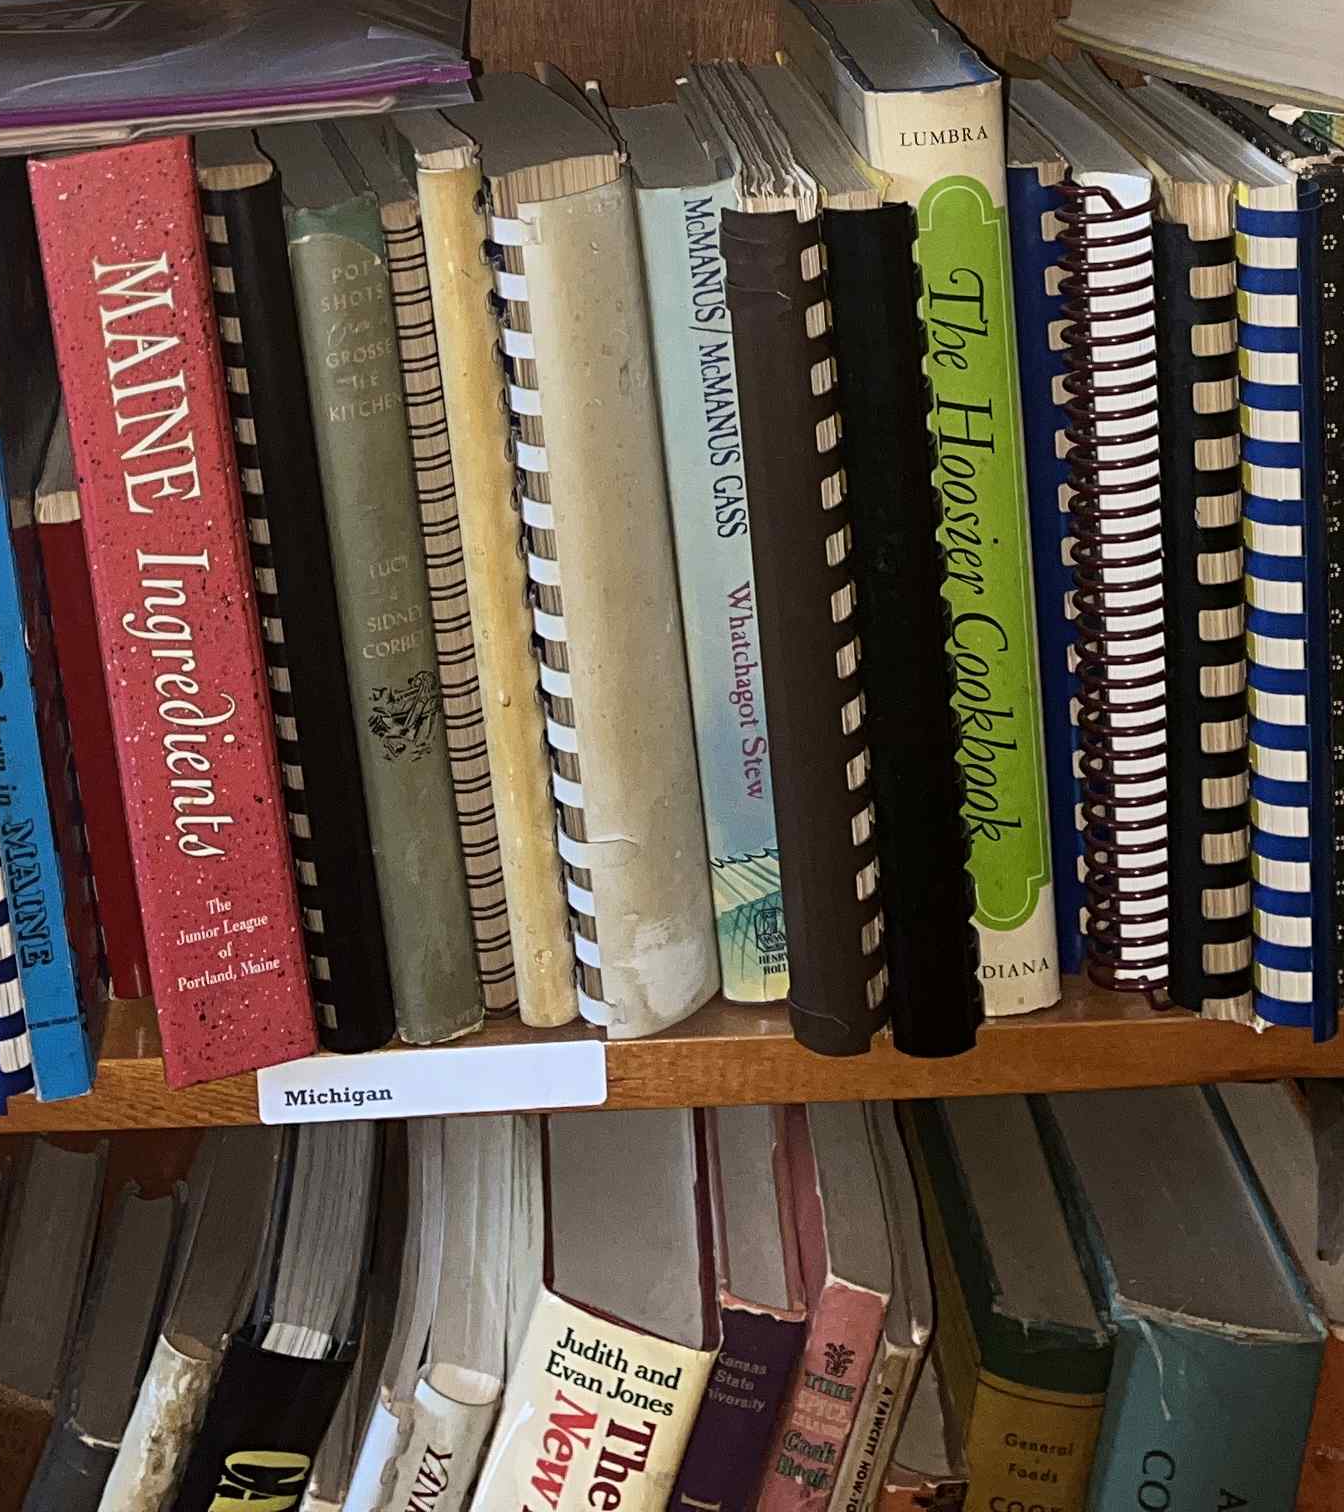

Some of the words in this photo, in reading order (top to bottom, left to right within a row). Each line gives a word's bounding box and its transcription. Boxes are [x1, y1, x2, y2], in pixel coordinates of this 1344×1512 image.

[899, 124, 990, 149] LUMBRA
[683, 195, 734, 335] McMANUS/
[927, 268, 990, 372] The
[91, 251, 203, 515] MAINE
[698, 343, 741, 466] McMANUS
[712, 467, 748, 539] GASS
[935, 397, 1001, 596] Hoosier
[725, 580, 762, 736] Whatchagot
[122, 548, 236, 859] Ingredients
[949, 610, 1024, 845] Cookbook
[741, 734, 769, 801] Stew
[1, 819, 52, 968] MAINE
[175, 924, 220, 945] Junior
[222, 912, 270, 936] League
[176, 969, 238, 993] Portland,
[240, 957, 281, 979] Maine
[283, 1086, 394, 1106] Michigan
[544, 1351, 611, 1394] Evan
[606, 1377, 674, 1417] Jones
[556, 1326, 630, 1371] Judith
[634, 1364, 682, 1391] and
[1005, 1431, 1074, 1457] General
[1006, 1462, 1059, 1483] Foods
